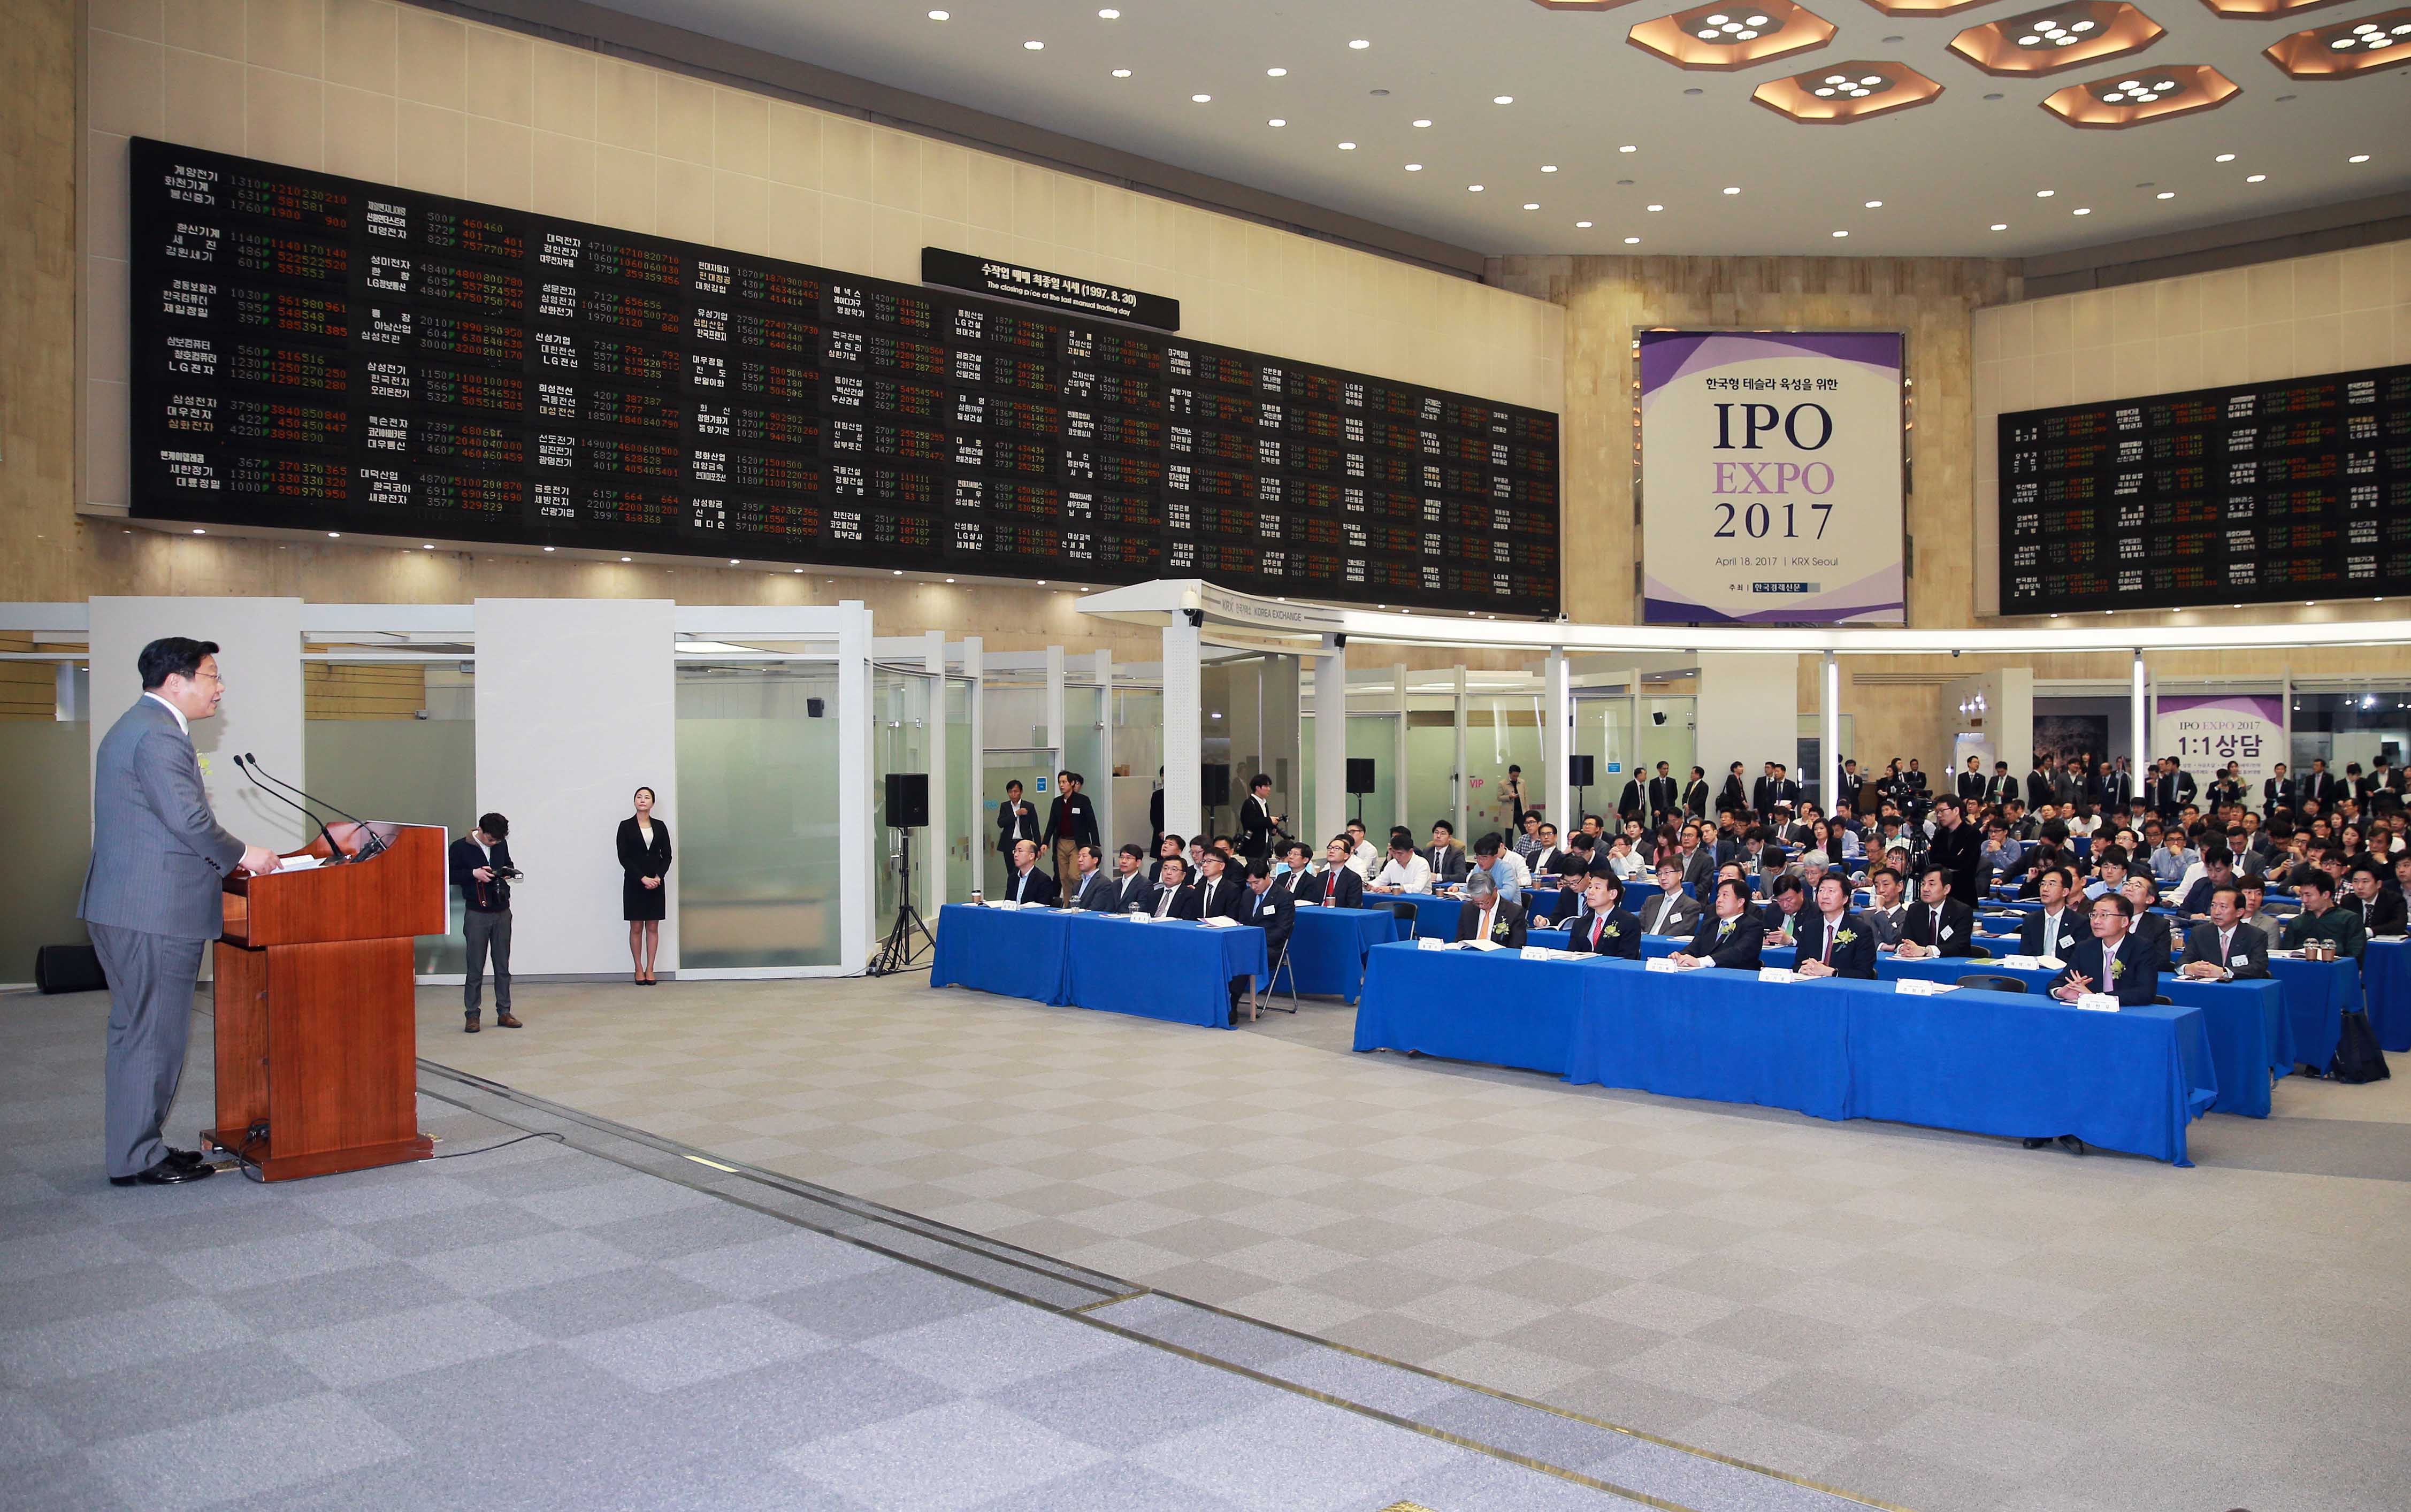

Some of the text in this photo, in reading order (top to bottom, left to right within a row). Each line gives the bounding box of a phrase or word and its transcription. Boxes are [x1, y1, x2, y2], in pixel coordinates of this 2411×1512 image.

[175, 165, 261, 190] 계양전기 1310
[165, 176, 261, 202] 화천기계 631
[231, 199, 261, 214] 1760
[177, 223, 261, 245] 한신기계 1140
[368, 225, 407, 239] 대영전자
[547, 233, 581, 248] 대덕전자
[238, 244, 261, 257] 486
[544, 244, 578, 258] 경인전자
[238, 257, 261, 270] 601
[371, 256, 411, 270] 성미전자
[540, 255, 574, 268] 대우전자부품
[698, 261, 729, 274] 현대자동차
[542, 283, 576, 296] 성문전자
[695, 281, 726, 294] 대원강업
[981, 263, 1009, 280] 수작업
[1032, 273, 1060, 290] 최종일
[1061, 280, 1080, 294] 시세
[1081, 283, 1110, 300] (1997.
[1111, 290, 1121, 302] 8.
[1121, 293, 1137, 307] 30)
[231, 287, 261, 301] 1030
[541, 294, 576, 307] 삼영전자
[987, 280, 1130, 317] The closing price of the last manual trading day
[163, 290, 261, 313] 한국컴퓨터 595
[164, 303, 261, 325] 제일정밀 397
[539, 304, 573, 317] 삼화전기
[698, 309, 728, 321] 유성기업
[374, 321, 411, 334] 아남산업
[362, 331, 400, 344] 삼성전관
[535, 333, 570, 346] 신성기업
[167, 336, 261, 357] 삼보컴퓨터 560
[541, 344, 575, 357] 대한전선
[231, 356, 261, 369] 1230
[544, 355, 578, 368] LG전선
[692, 355, 723, 367] 대우정밀
[169, 361, 261, 381] LG전자 1260
[368, 362, 405, 375] 삼성전기
[371, 374, 409, 387] 한국전자
[694, 376, 724, 387] 한일이화
[1706, 378, 1839, 391] 한국형 테슬라 육성을 위한
[371, 386, 409, 398] 오리온전기
[173, 395, 261, 412] 삼성전자 3790
[542, 394, 576, 407] 극동전선
[167, 406, 261, 424] 대우전자 422
[540, 405, 575, 418] 대성전선
[168, 419, 261, 436] 삼화전자 4220
[699, 424, 729, 435] 동양기전
[1713, 403, 1833, 451] IPO
[368, 439, 405, 451] 대우통신
[539, 434, 575, 446] 선도전기
[539, 445, 572, 456] 일진전기
[695, 450, 725, 462] 평화산업
[238, 457, 261, 468] 367
[539, 456, 571, 467] 광명전기
[693, 461, 723, 472] 태양금속
[170, 464, 261, 481] 새한정기 1310
[361, 469, 398, 480] 대덕산업
[1712, 462, 1835, 495] EXPO
[231, 481, 261, 493] 1000
[373, 481, 411, 493] 한국코아
[535, 484, 569, 495] 금호전기
[369, 493, 407, 504] 새한전자
[534, 495, 569, 506] 세방전지
[693, 498, 723, 509] 삼성항공
[541, 506, 574, 517] 신광기업
[1714, 503, 1833, 540] 2017
[1716, 557, 1839, 567] April 18. 2017 KRX Seoul
[1755, 584, 1801, 592] 한국경제신문
[1254, 607, 1272, 618] KOREA
[1272, 610, 1302, 621] EXCHANGE
[2179, 722, 2260, 731] IPO EXPO 2017
[1469, 779, 1484, 788] VIP
